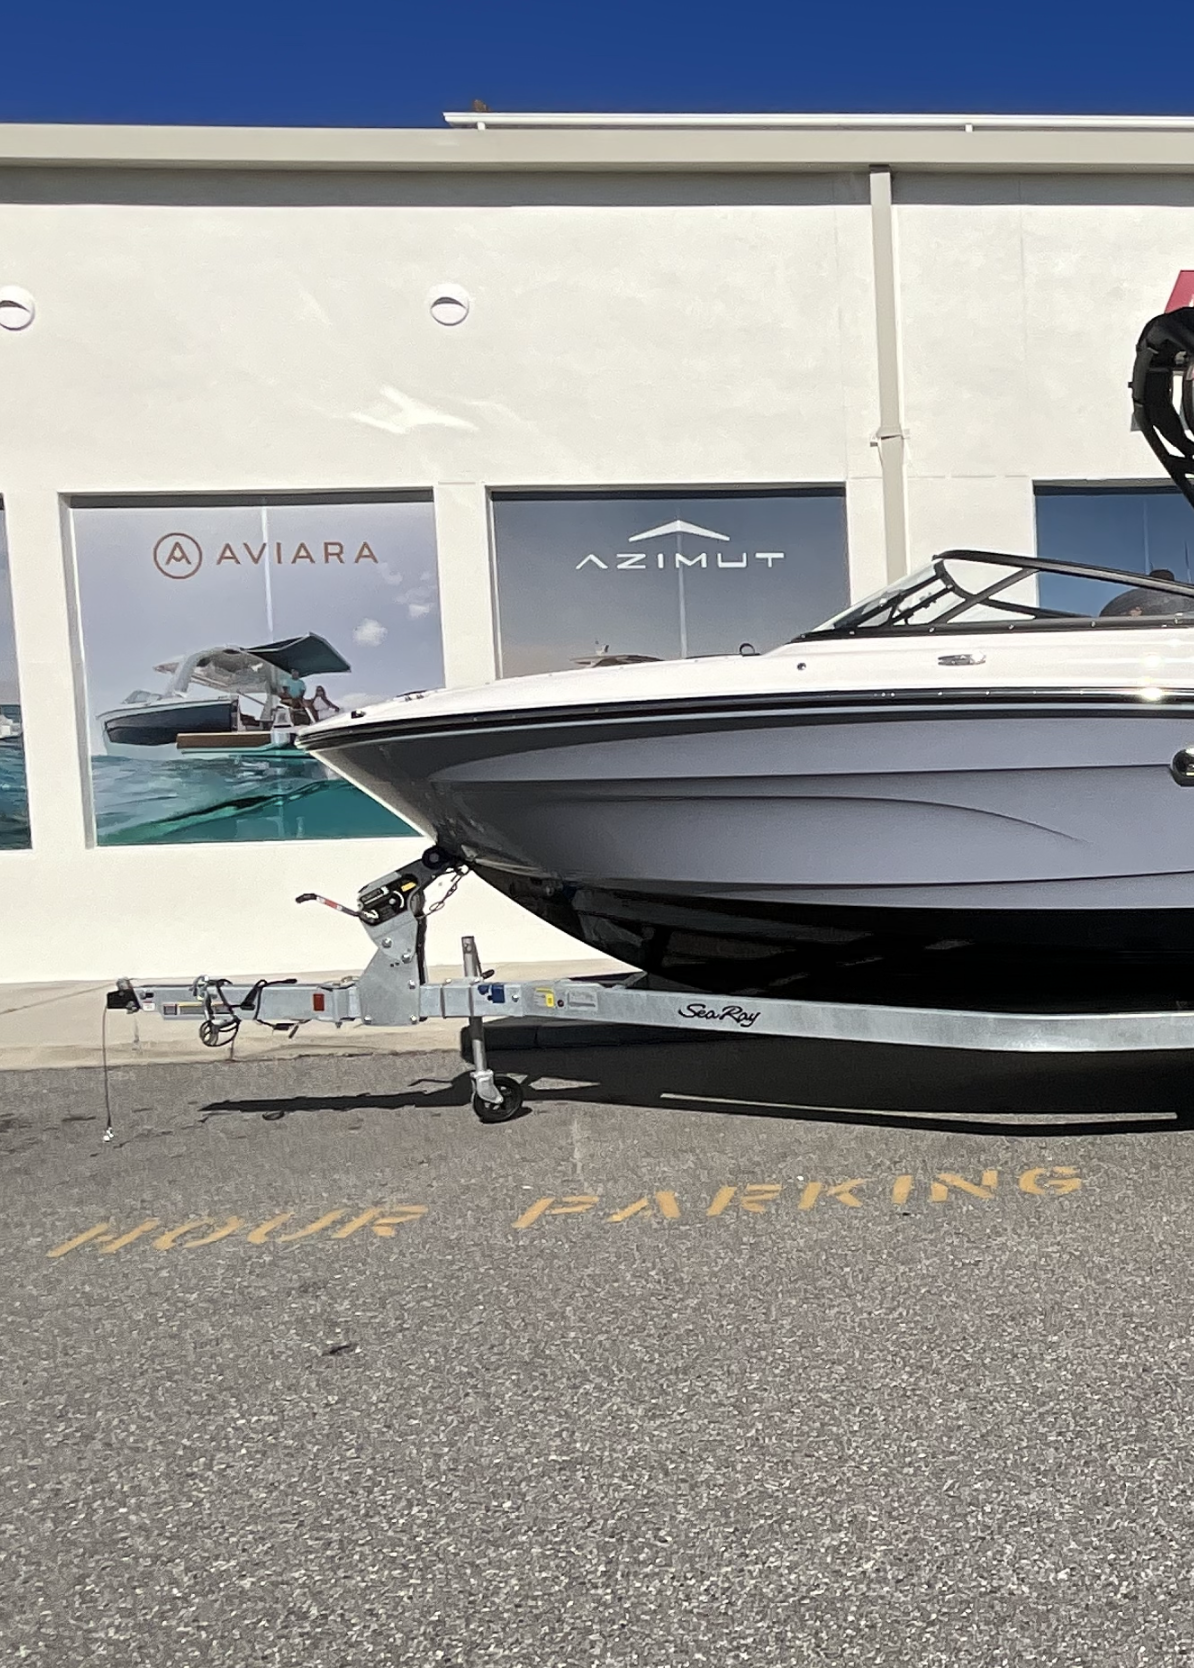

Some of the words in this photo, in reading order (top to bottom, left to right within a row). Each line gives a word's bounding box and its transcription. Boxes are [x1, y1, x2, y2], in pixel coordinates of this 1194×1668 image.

[216, 541, 379, 566] AVIARA
[575, 552, 785, 570] AZIMUT
[678, 1003, 719, 1020] Sea
[719, 1005, 761, 1027] Ray
[46, 1205, 429, 1258] HOUR
[511, 1167, 1083, 1229] PARKING
